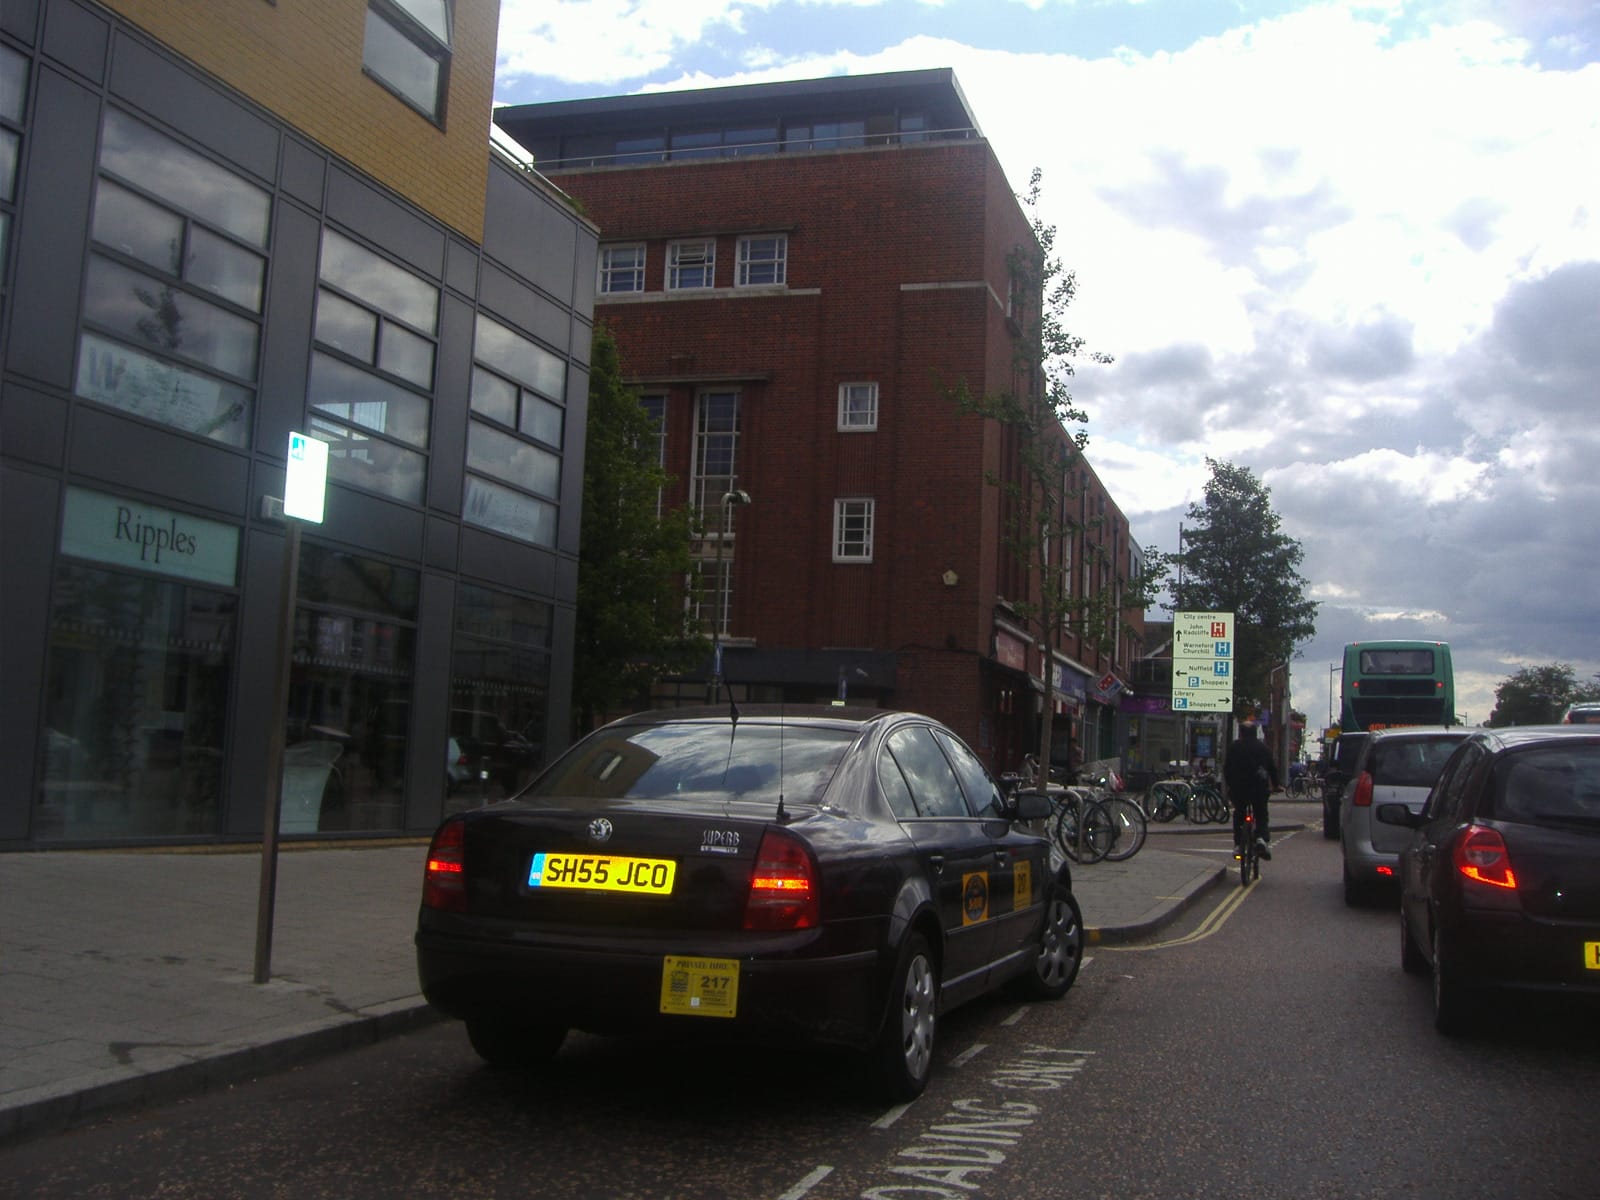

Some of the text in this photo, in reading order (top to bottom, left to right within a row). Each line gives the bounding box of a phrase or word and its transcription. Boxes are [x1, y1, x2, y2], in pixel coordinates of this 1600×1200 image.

[114, 506, 197, 564] Ripples
[1201, 679, 1228, 687] Shoppers
[702, 830, 740, 846] SUPERB
[547, 858, 668, 888] SH55 JCO
[701, 976, 730, 989] 217
[988, 1043, 1096, 1090] ONLY
